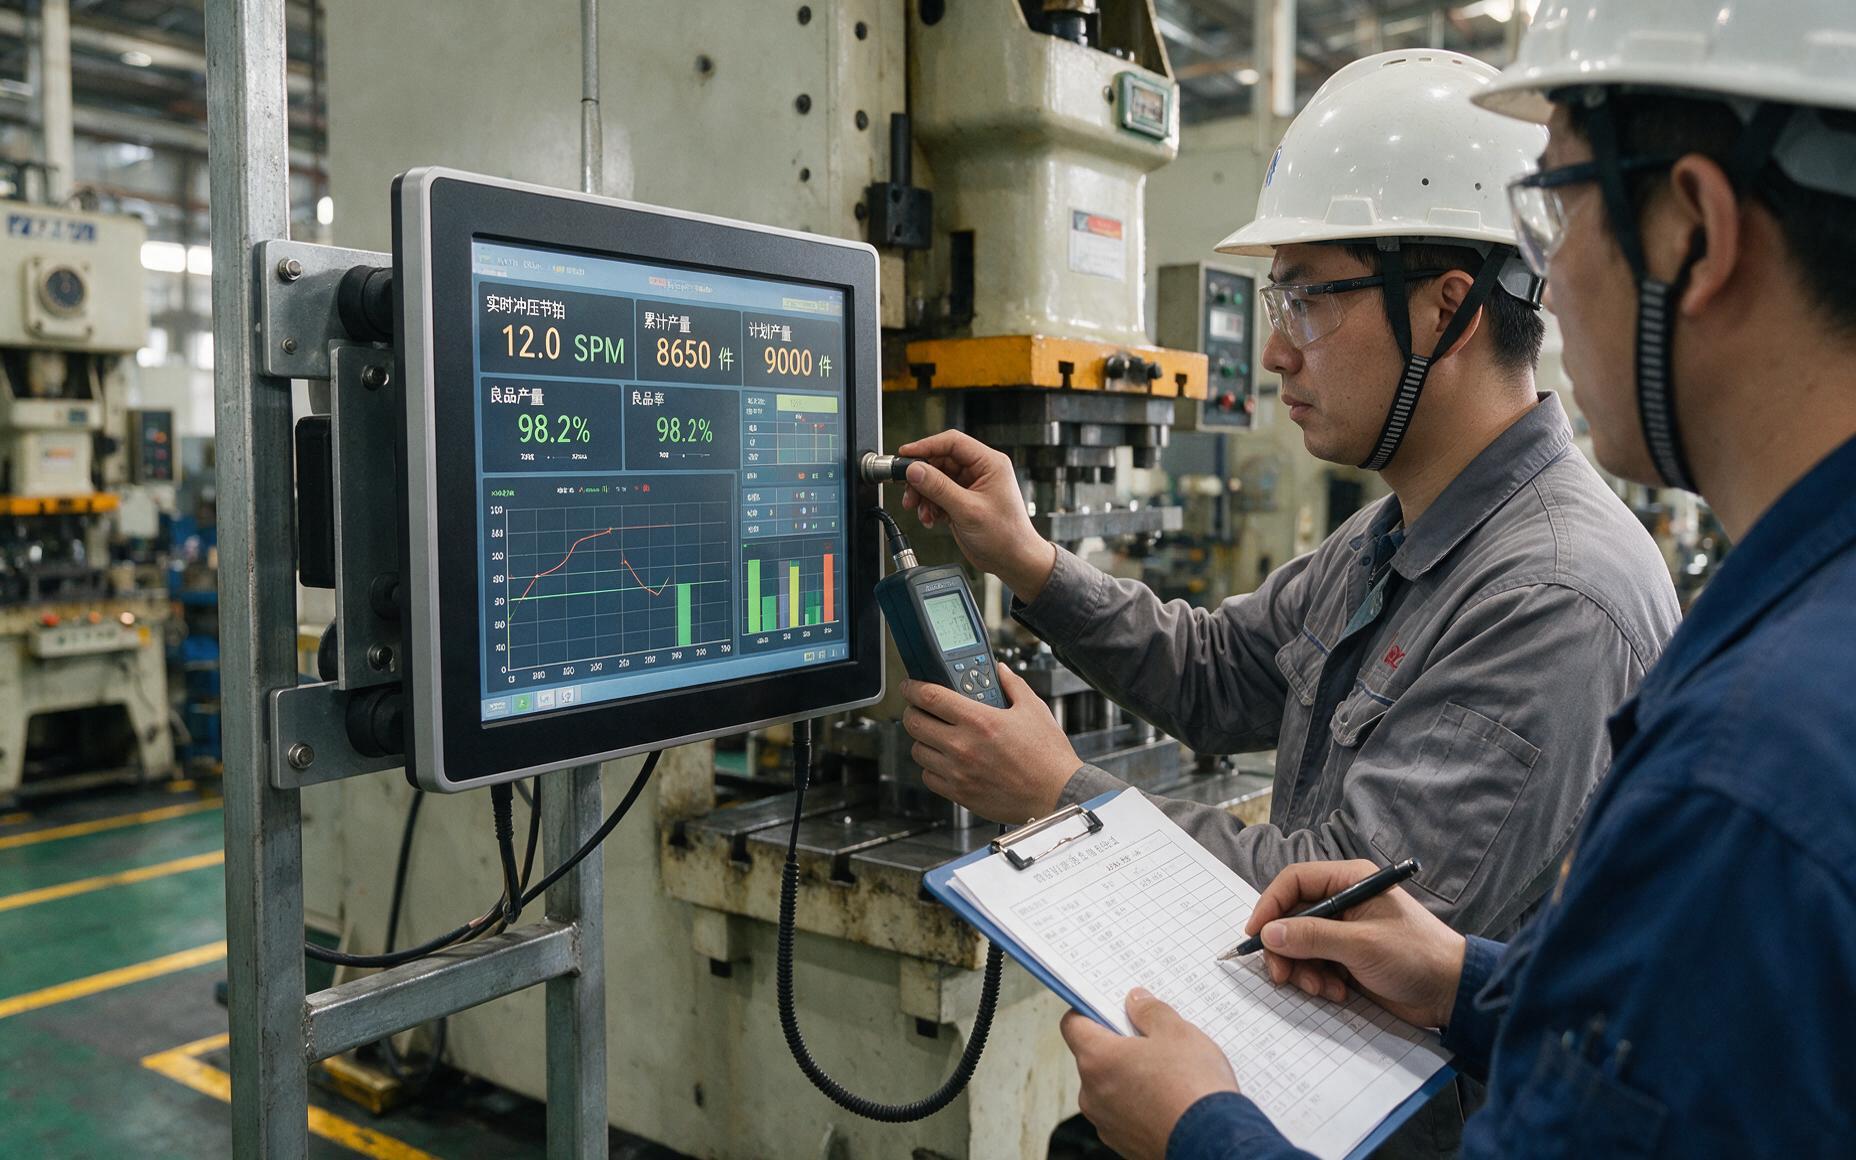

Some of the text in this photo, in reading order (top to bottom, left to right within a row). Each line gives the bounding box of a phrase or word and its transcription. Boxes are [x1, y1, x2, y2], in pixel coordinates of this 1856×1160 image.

[486, 294, 566, 319] 实时冲压节拍
[644, 311, 692, 334] 累计产量
[749, 321, 793, 342] 计划产量
[502, 324, 625, 364] 12.0 SPM
[656, 337, 735, 372] 8650 件
[764, 346, 833, 378] 9000 件
[490, 385, 545, 406] 良品产量
[631, 390, 666, 407] 良品率
[518, 413, 591, 444] 98.2%
[656, 416, 714, 444] 98.2%
